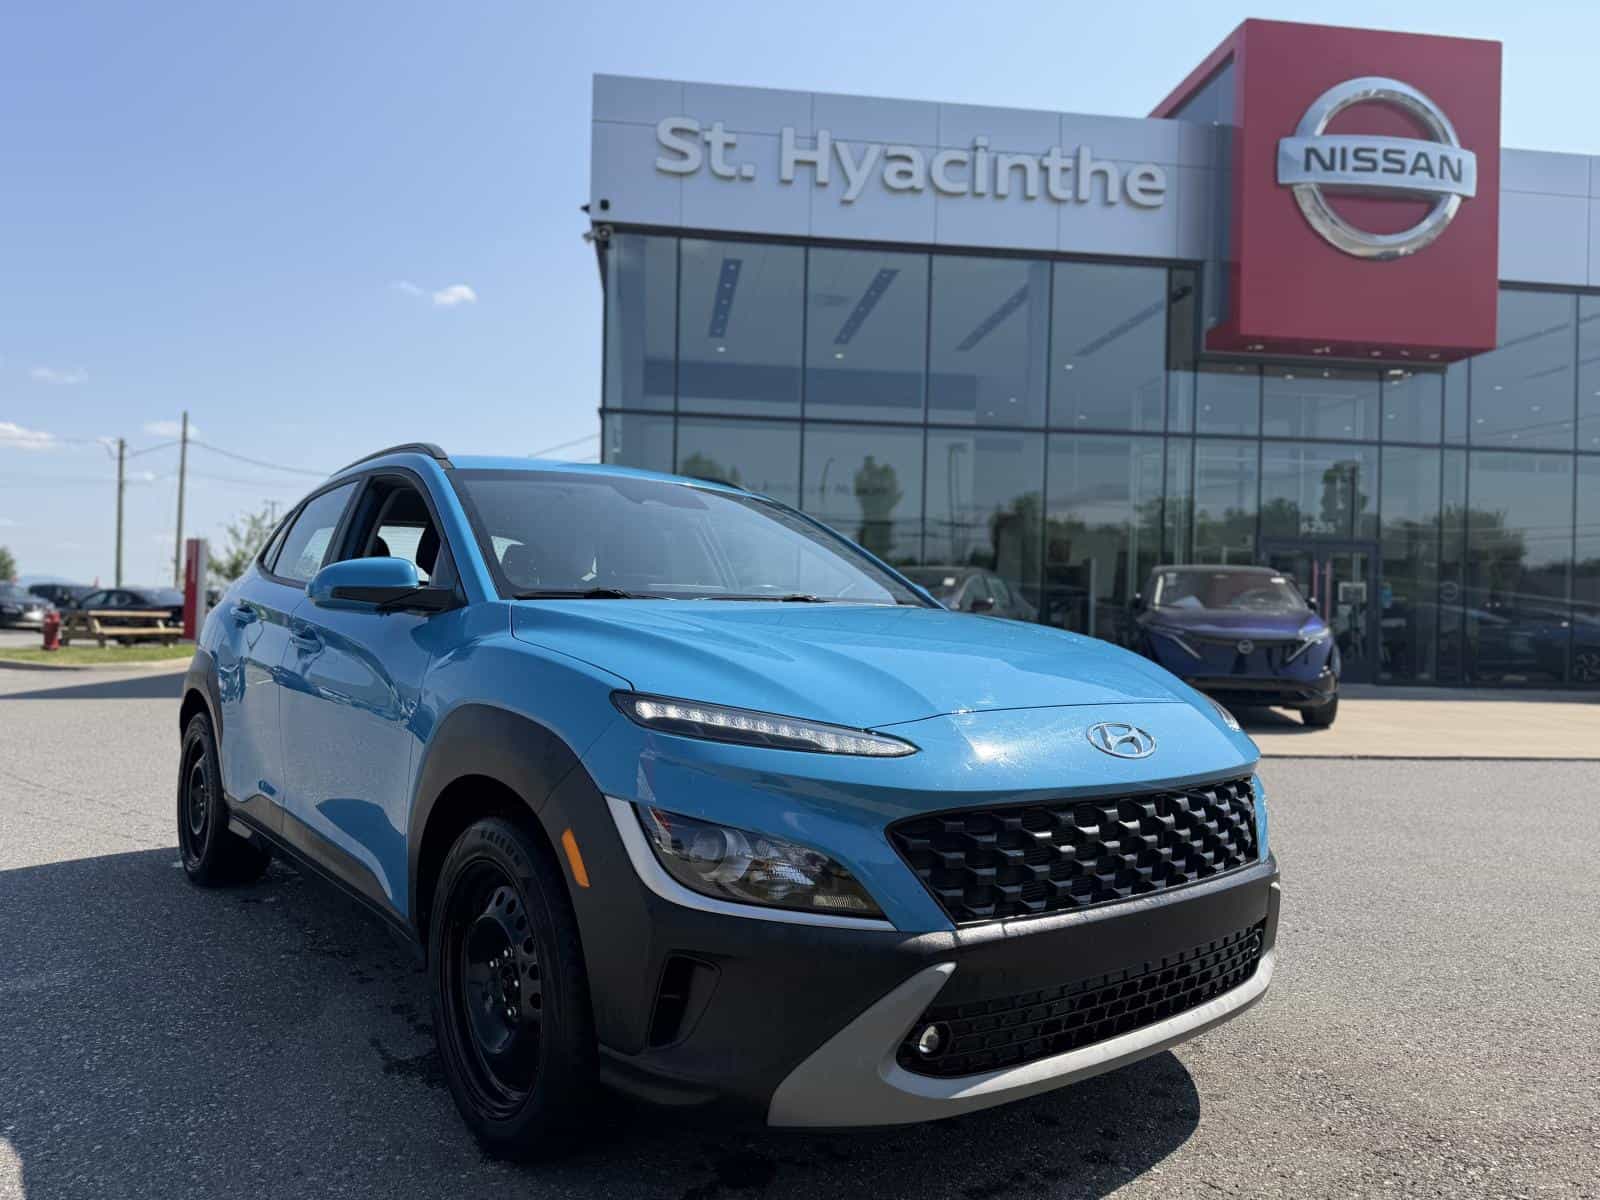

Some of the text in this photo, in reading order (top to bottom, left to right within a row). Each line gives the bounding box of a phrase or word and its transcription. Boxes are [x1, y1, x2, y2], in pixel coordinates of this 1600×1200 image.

[655, 116, 1167, 208] St. Hyacinthe
[1303, 146, 1463, 183] NISSAN
